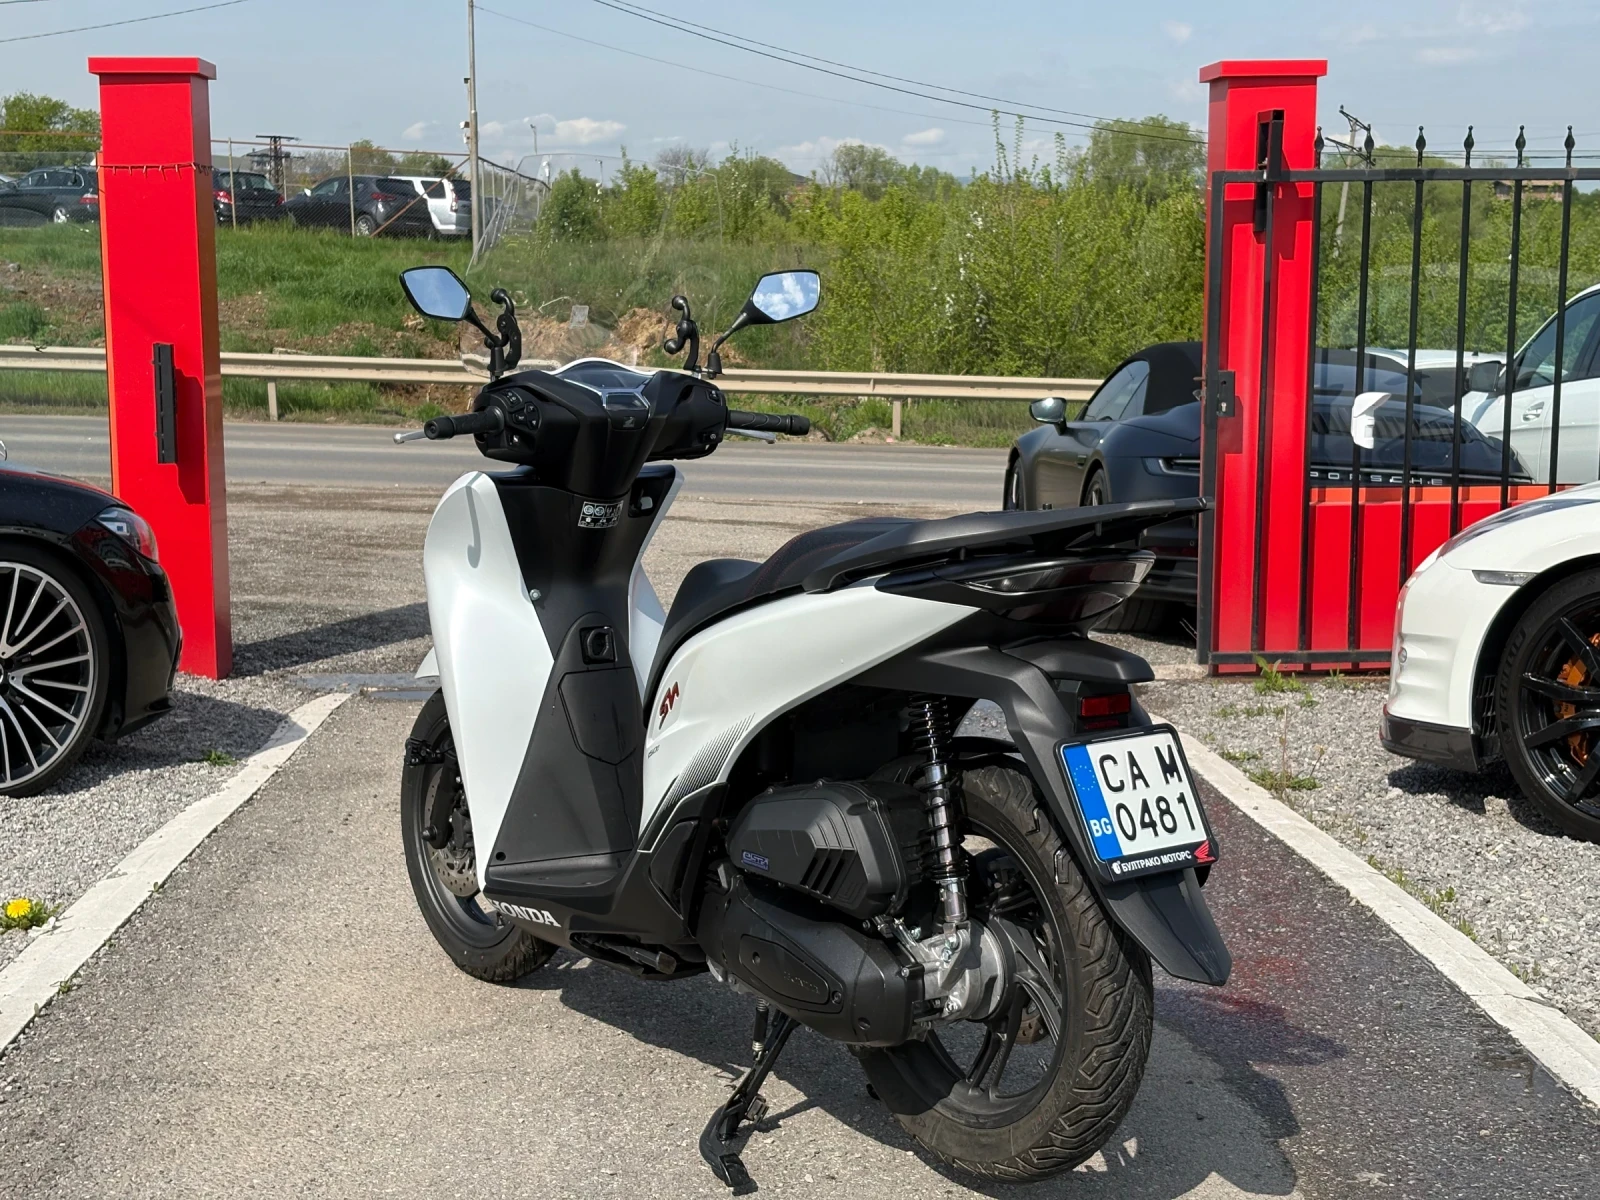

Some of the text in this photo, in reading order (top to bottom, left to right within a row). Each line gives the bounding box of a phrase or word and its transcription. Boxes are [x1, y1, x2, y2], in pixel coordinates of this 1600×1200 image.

[1098, 744, 1183, 793] CA M
[1089, 816, 1113, 838] BG
[1115, 791, 1196, 842] 0481
[1120, 856, 1161, 873] БУЛТРАКО
[1160, 850, 1192, 864] МОТОРС
